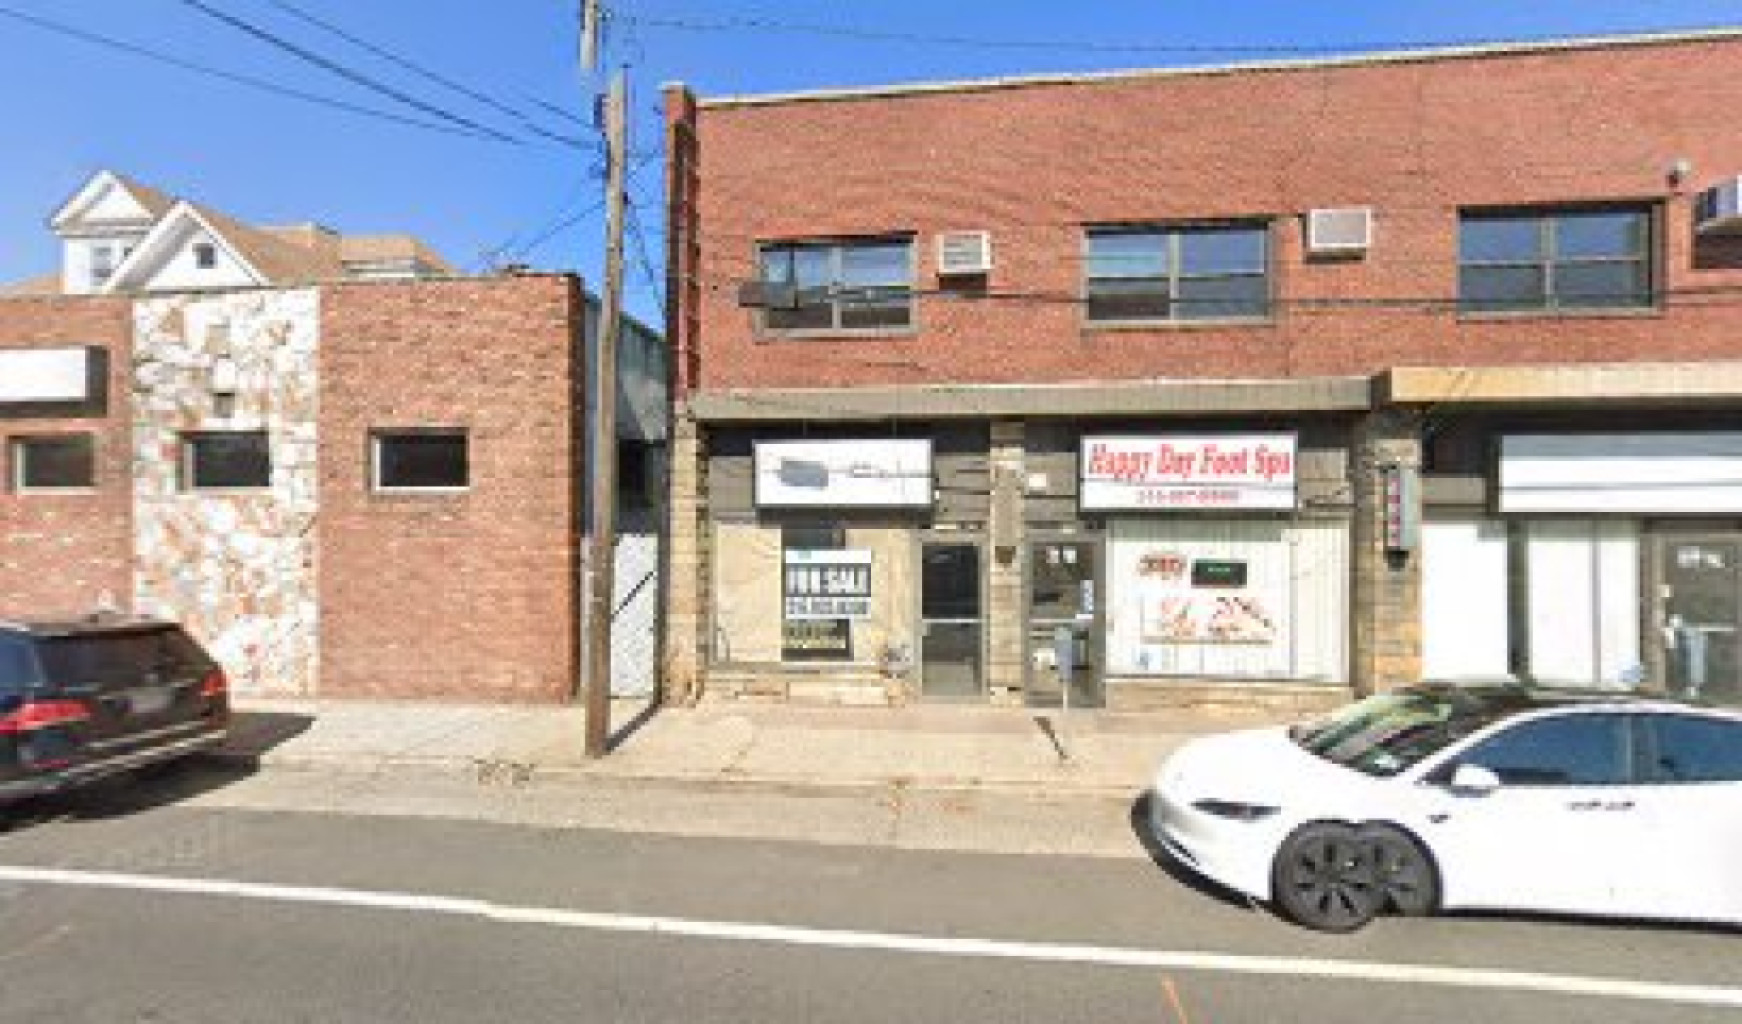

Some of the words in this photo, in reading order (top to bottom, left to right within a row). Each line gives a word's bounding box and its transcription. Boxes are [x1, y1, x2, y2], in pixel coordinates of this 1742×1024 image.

[1088, 443, 1153, 482] Happy
[1157, 443, 1196, 480] Day
[1199, 443, 1248, 476] Foot
[1254, 443, 1291, 481] Spa
[787, 567, 820, 594] FOR
[823, 567, 868, 594] SALE
